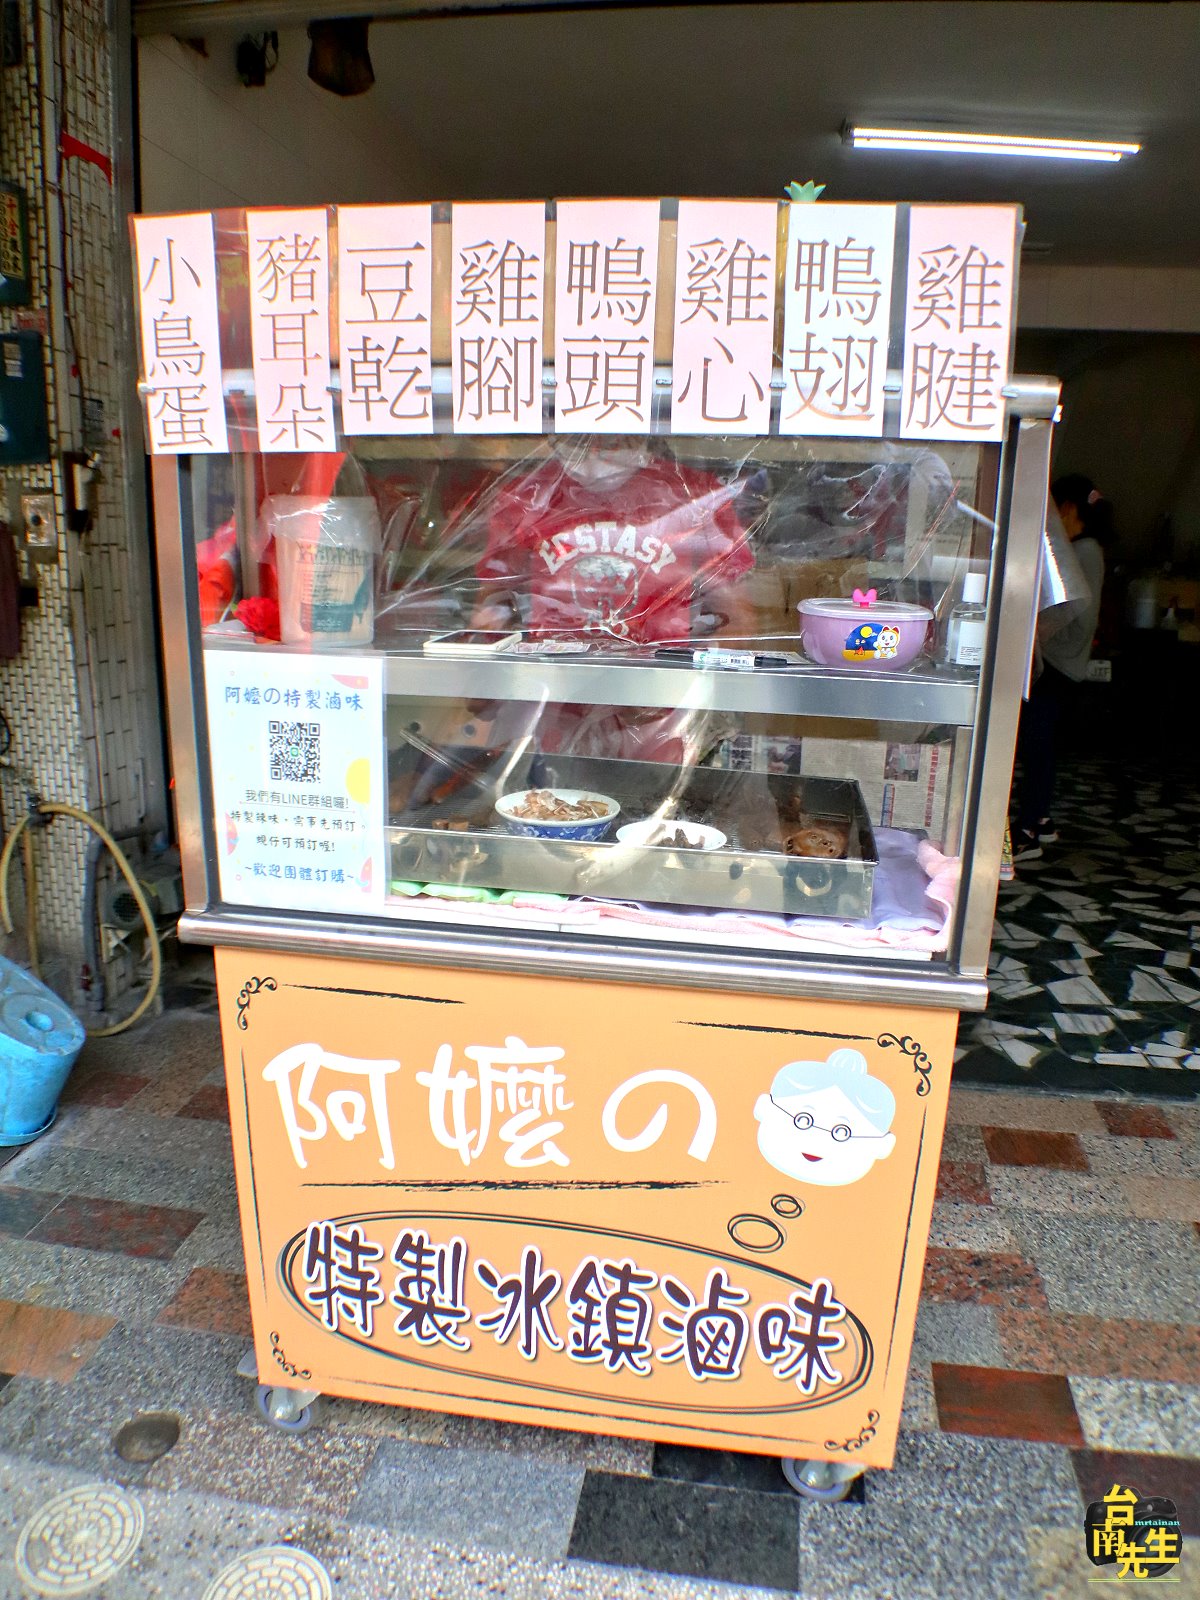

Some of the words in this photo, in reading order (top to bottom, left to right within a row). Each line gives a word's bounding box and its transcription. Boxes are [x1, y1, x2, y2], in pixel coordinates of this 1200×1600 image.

[142, 237, 214, 449] 小鳥蛋
[255, 232, 326, 449] 豬耳朵
[345, 240, 430, 422] 豆乾
[455, 239, 541, 422] 雞腳
[561, 237, 652, 422] 鴨頭
[677, 237, 772, 423] 雞心
[784, 236, 883, 421] 鴨翅
[905, 244, 1005, 431] 雞腱
[225, 686, 364, 711] 阿嬤の特製滷味
[262, 1036, 718, 1170] 阿嬤の
[302, 1220, 848, 1396] 特製冰鎮滷味
